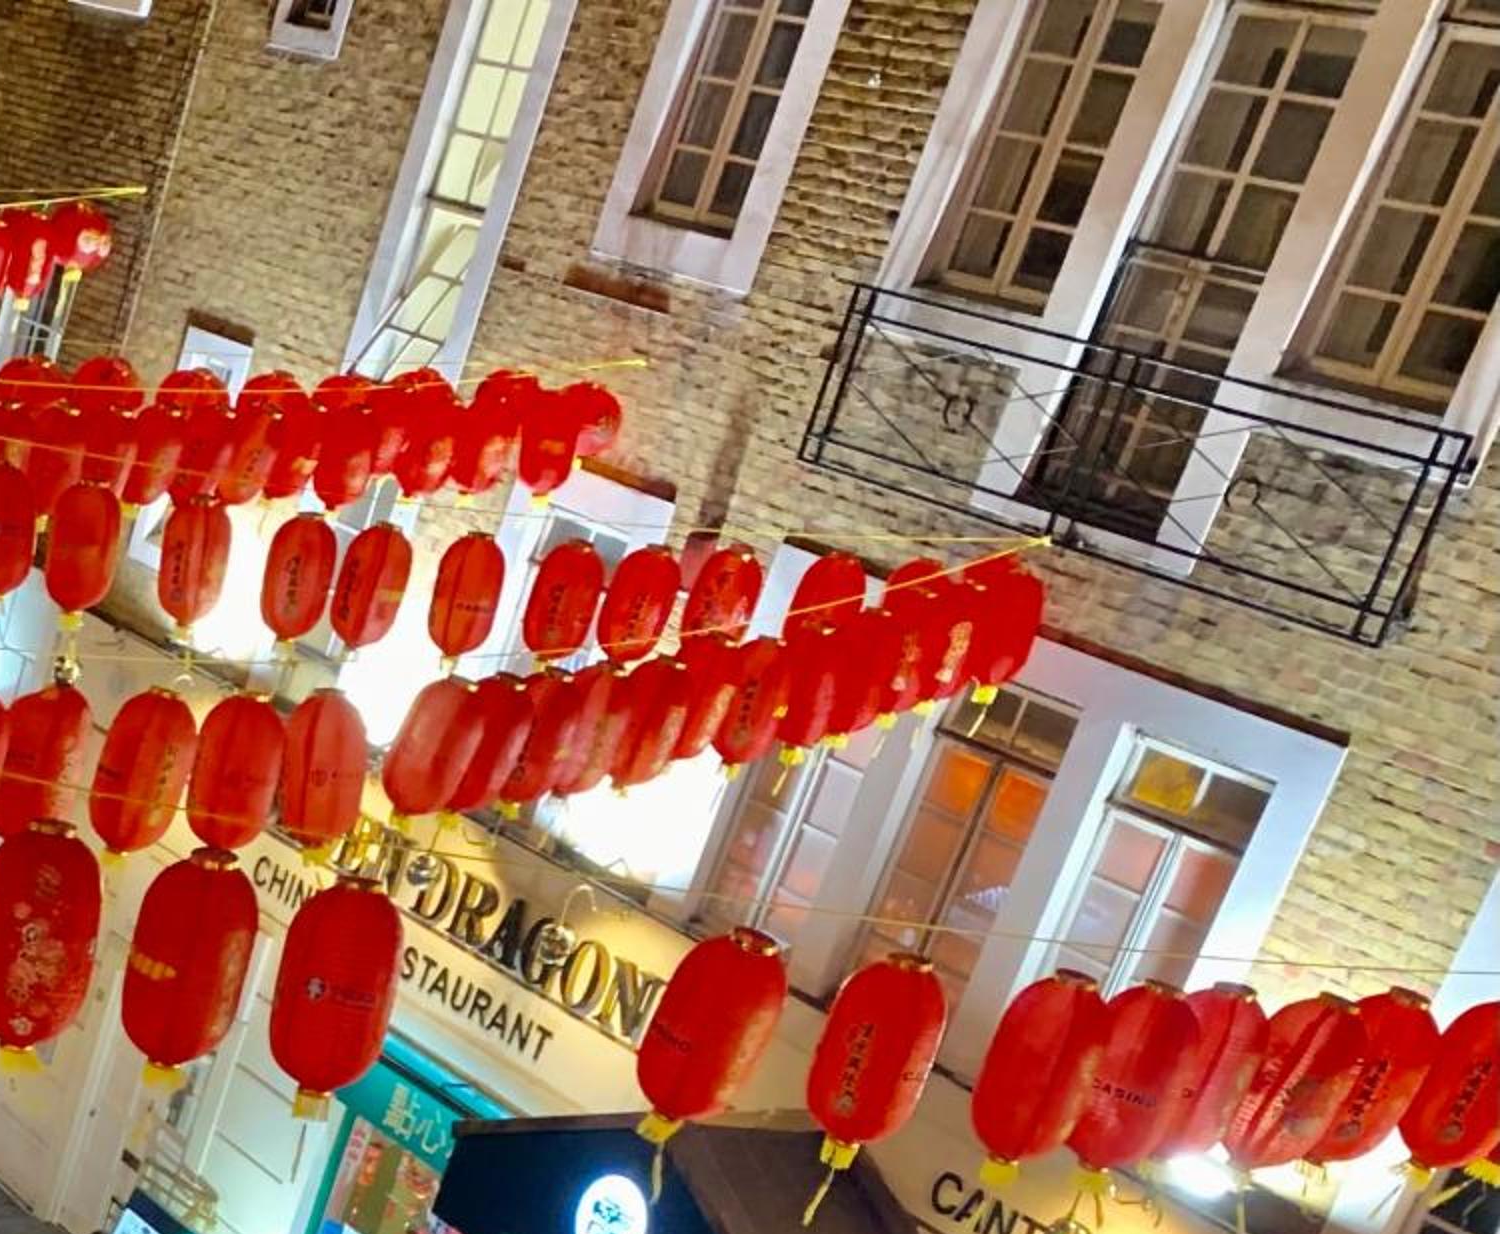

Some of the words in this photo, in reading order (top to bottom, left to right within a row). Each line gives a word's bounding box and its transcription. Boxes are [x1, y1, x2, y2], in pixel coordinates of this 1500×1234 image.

[408, 848, 668, 1043] DRAGON
[403, 946, 553, 1062] STAURANT
[382, 1082, 454, 1158] 點心
